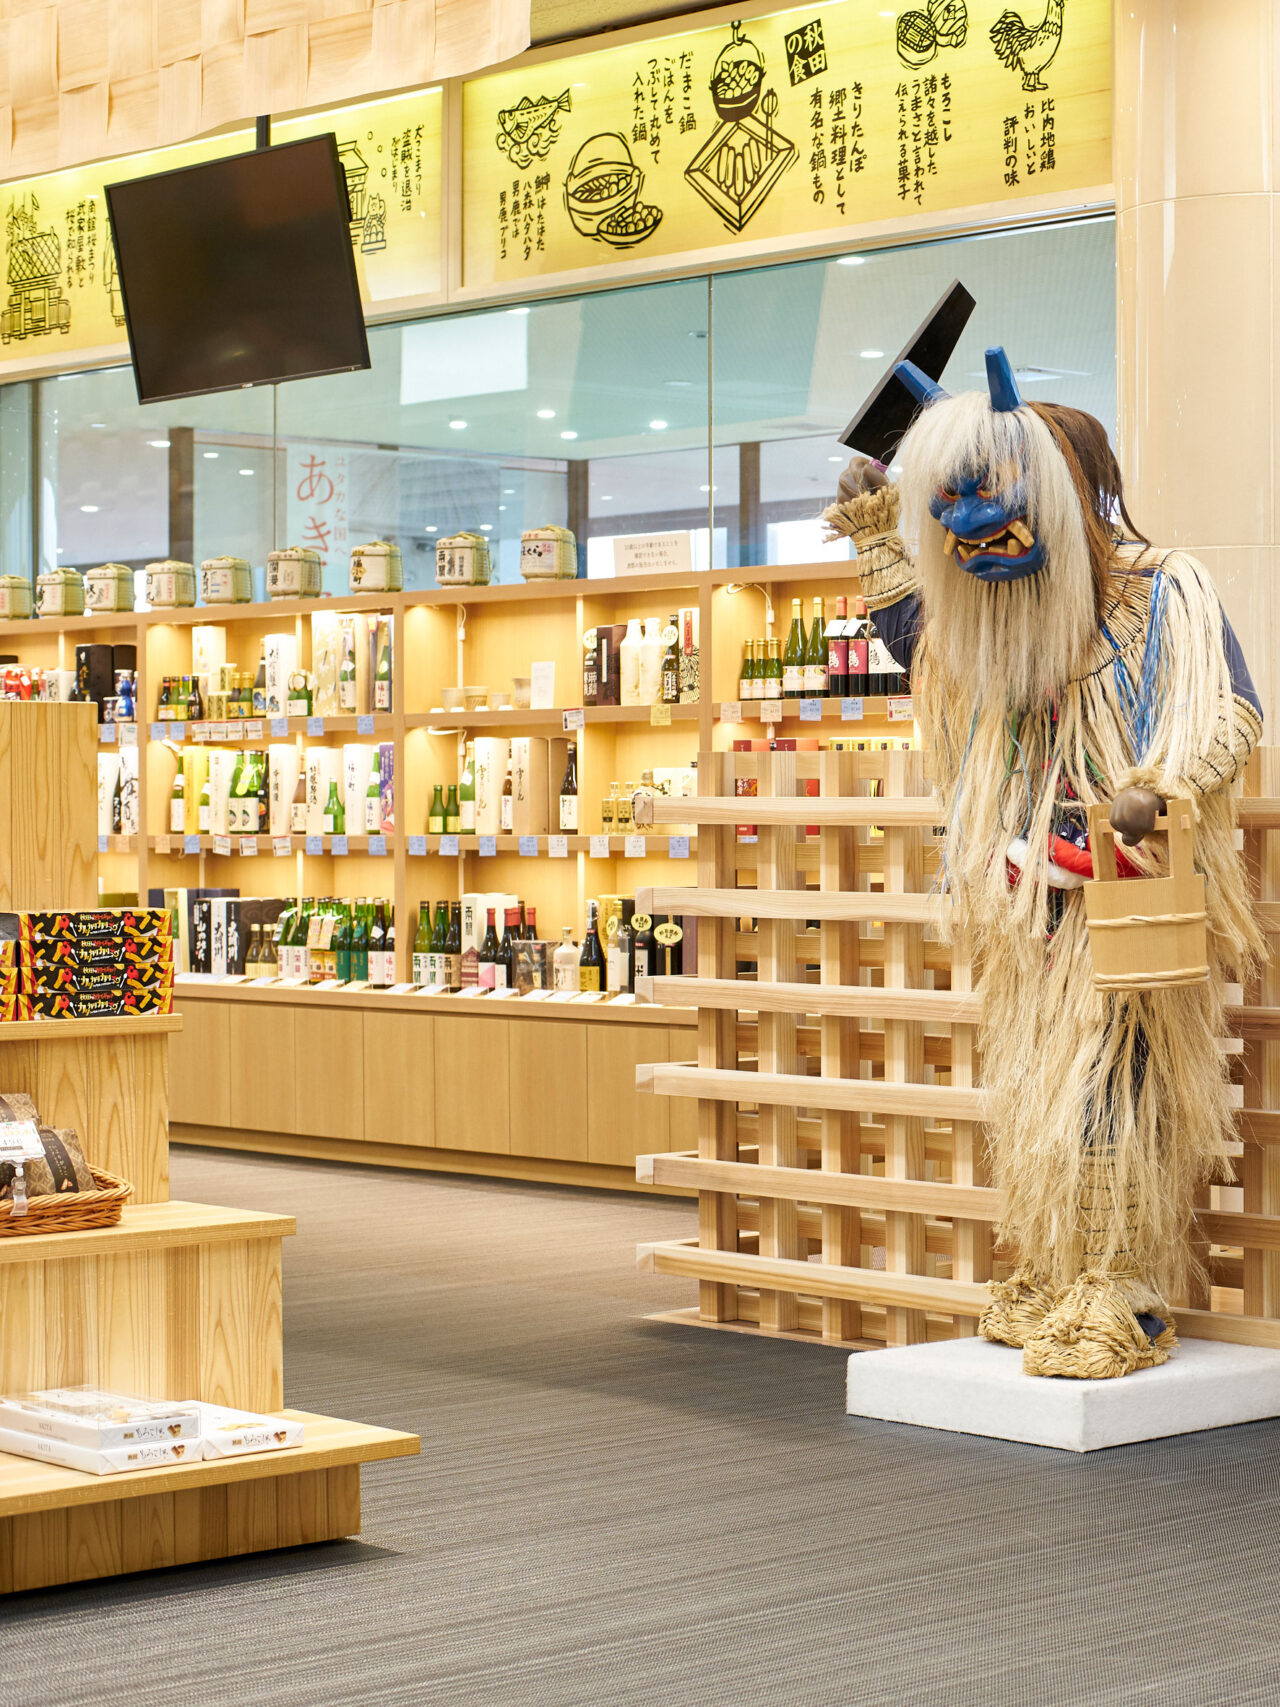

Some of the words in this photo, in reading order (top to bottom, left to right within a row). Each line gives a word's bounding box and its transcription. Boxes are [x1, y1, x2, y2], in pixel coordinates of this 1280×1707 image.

[632, 72, 648, 144] 入れた鍋
[647, 58, 662, 165] つぶして丸めて
[664, 57, 676, 125] ごはんを
[679, 51, 696, 135] だまこ鍋
[850, 80, 868, 174] きりたんぽ
[922, 74, 939, 176] 諸々を越した
[940, 73, 952, 142] もろこし
[1040, 97, 1056, 173] 比内地鶏
[809, 87, 827, 205] 有名な鍋もの
[829, 88, 848, 216] 郷土料理として
[895, 82, 910, 201] 伝えられる菓子
[910, 79, 925, 206] うまさと言われて
[1003, 115, 1020, 187] 評判の味
[1024, 103, 1036, 176] おいしいと
